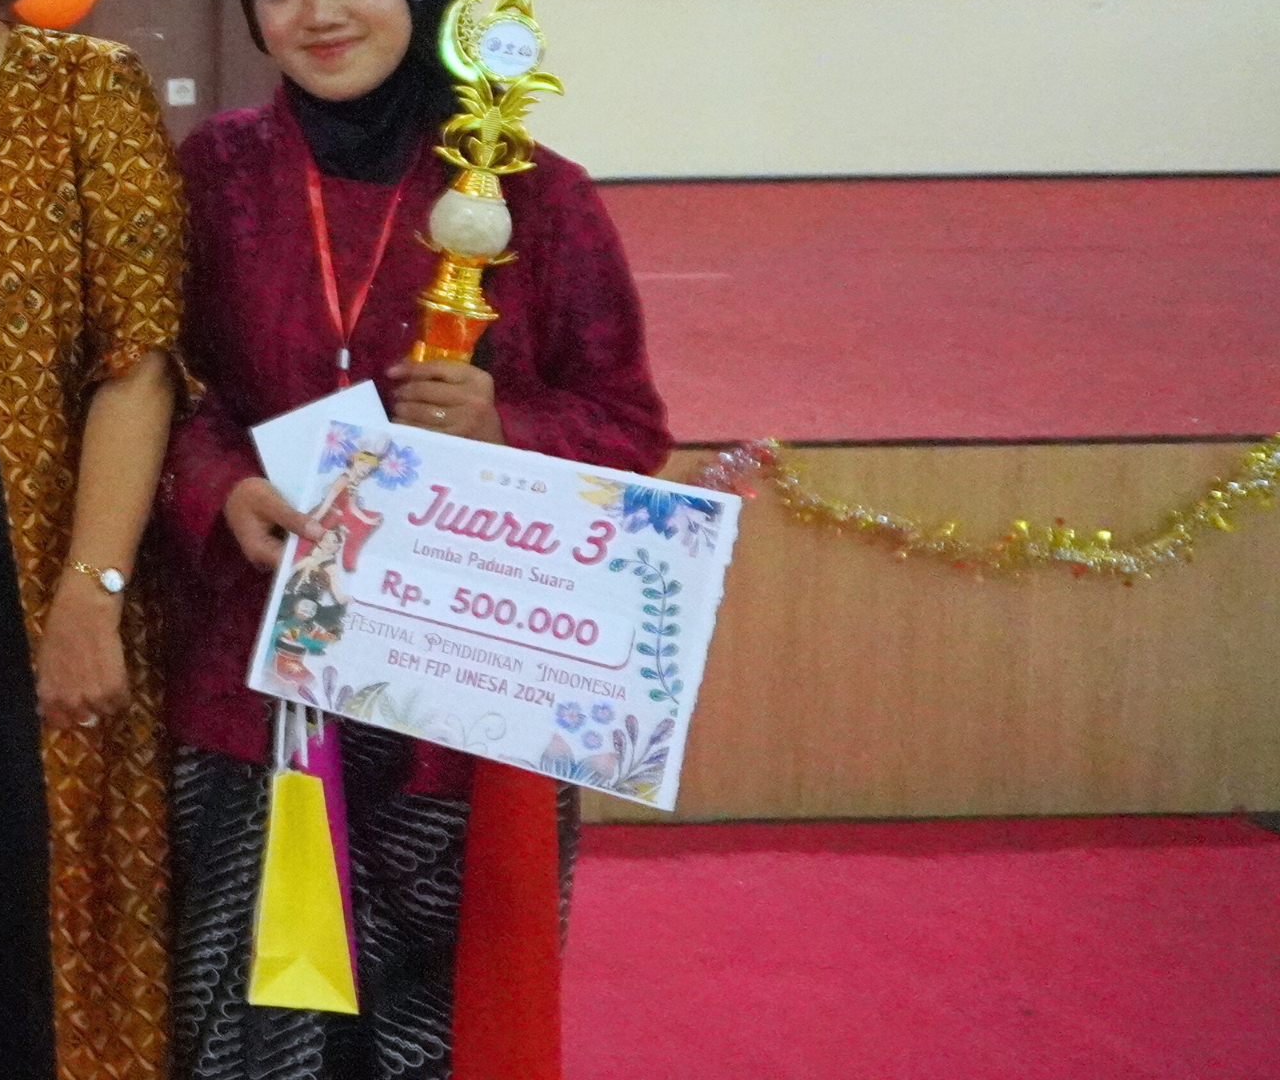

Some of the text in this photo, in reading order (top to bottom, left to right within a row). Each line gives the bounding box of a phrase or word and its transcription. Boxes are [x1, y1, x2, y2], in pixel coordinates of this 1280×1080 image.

[407, 484, 617, 565] Juara 3
[412, 538, 575, 592] Lomba Paduan Suara
[381, 569, 599, 646] Rp. 500.000
[341, 611, 627, 701] FESTIVAL PENDIDIKAN INDONESIA
[388, 649, 557, 708] BEM FIP UNESA 2024
